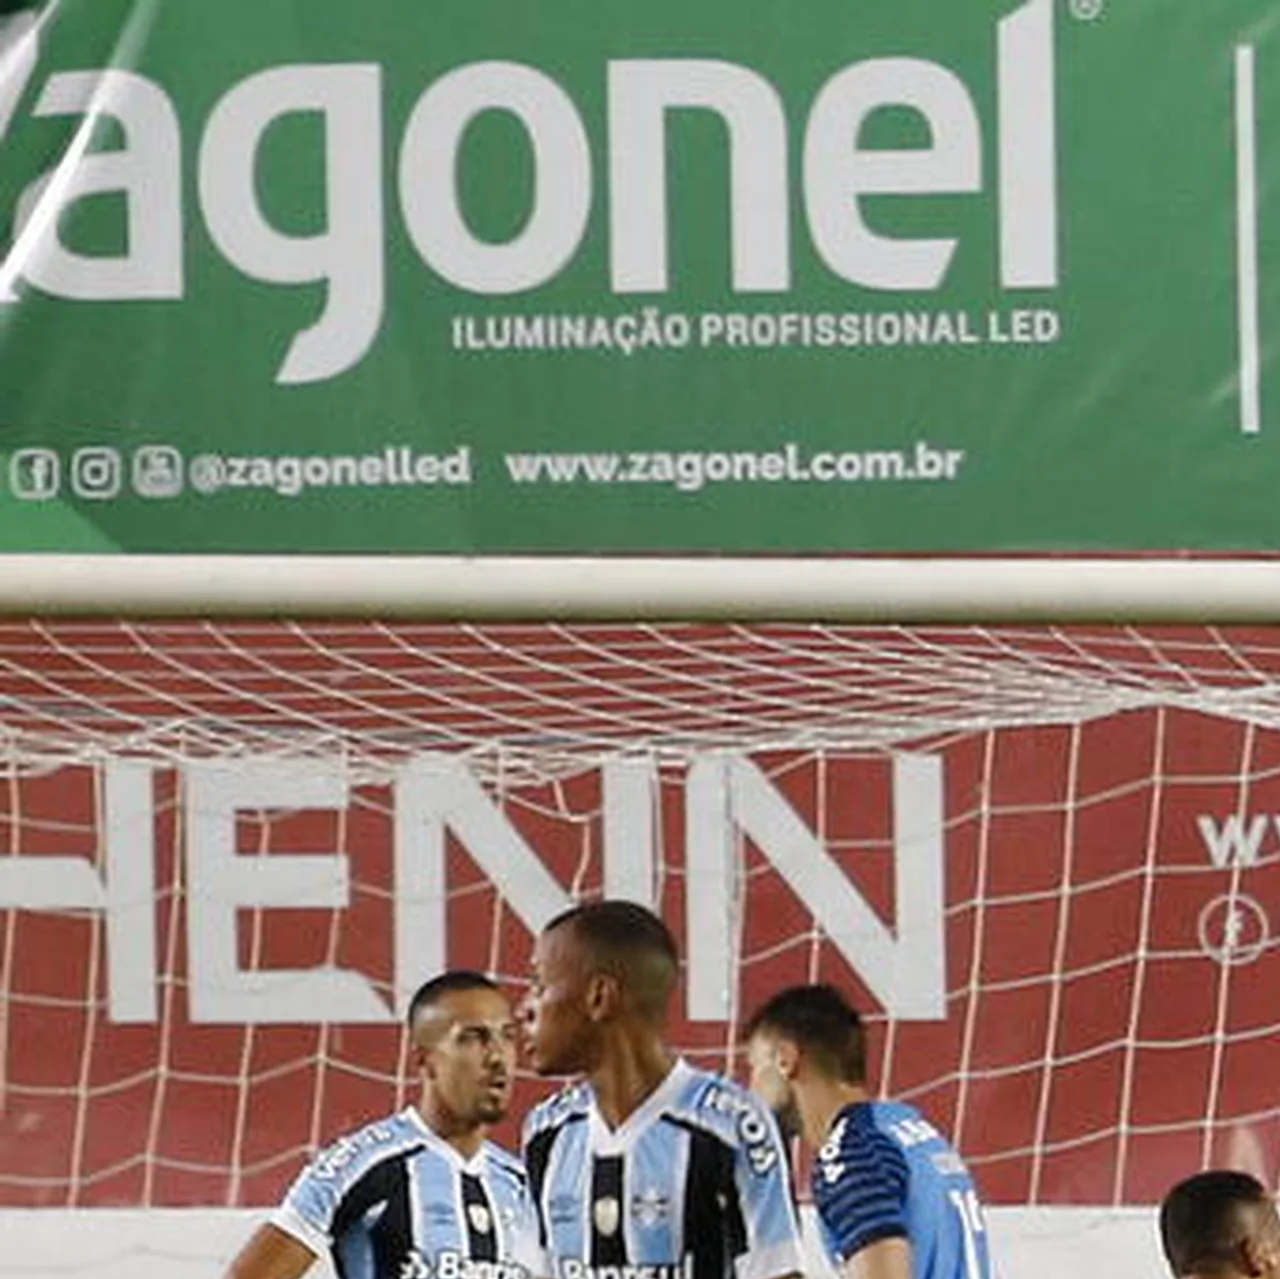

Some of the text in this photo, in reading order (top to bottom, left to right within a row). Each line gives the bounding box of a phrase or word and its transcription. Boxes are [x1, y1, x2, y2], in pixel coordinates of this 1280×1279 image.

[0, 0, 1060, 384] agonel
[453, 308, 1060, 354] ILUMINAÇÃO PROFISSIONAL LED
[191, 441, 965, 495] @zagonelled www.zagonel.com.br
